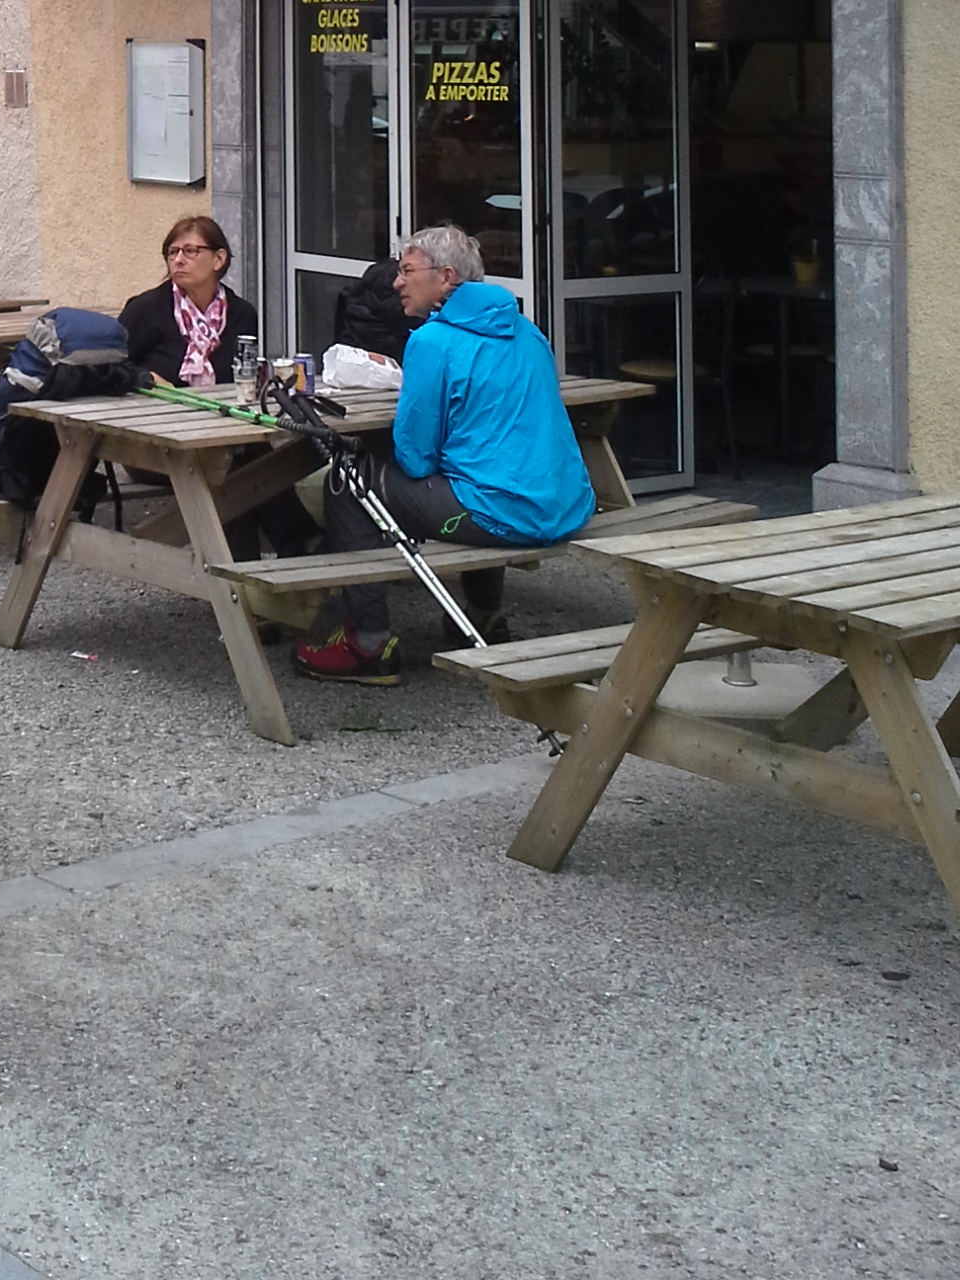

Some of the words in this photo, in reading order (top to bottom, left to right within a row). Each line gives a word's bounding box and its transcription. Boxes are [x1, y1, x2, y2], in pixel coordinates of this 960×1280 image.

[318, 8, 360, 28] GLACES
[310, 33, 369, 53] BOISSONS
[432, 61, 502, 84] PIZZAS
[425, 85, 436, 101] A
[439, 85, 510, 102] EMPORTER
